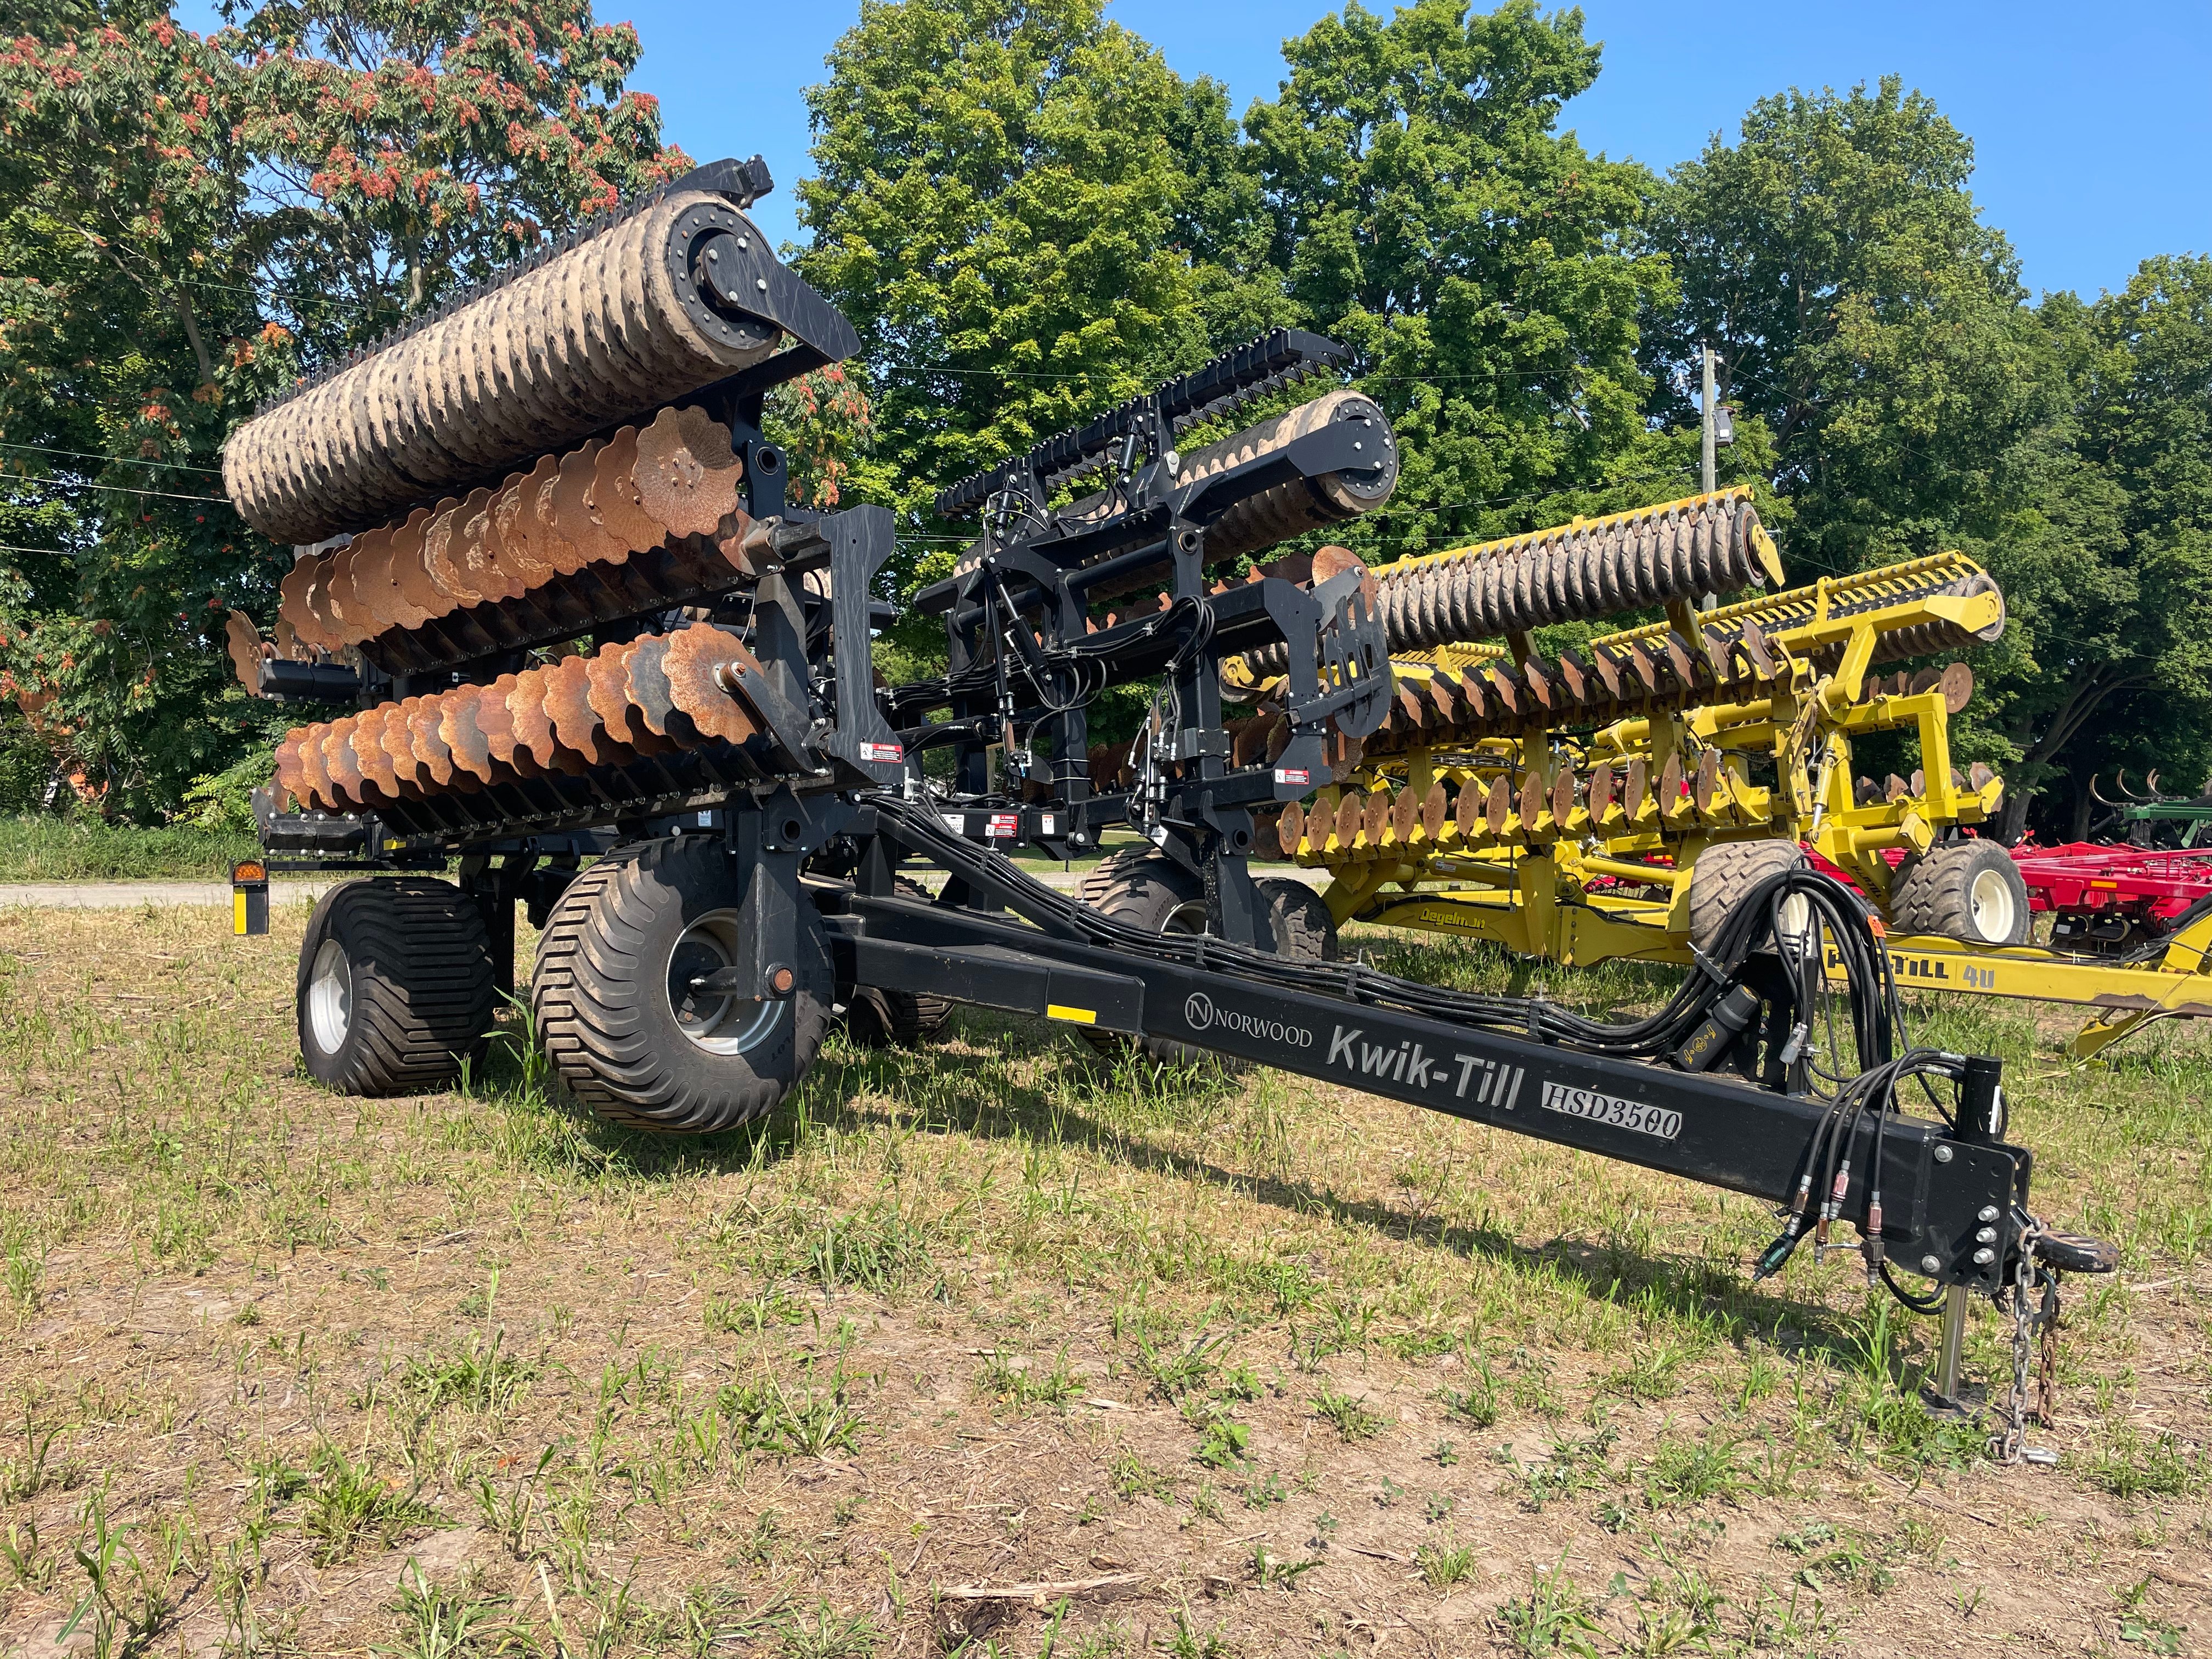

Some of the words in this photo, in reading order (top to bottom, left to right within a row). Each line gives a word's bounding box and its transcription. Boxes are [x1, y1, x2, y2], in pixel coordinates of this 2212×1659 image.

[1962, 964, 1995, 989] 4U
[1215, 1008, 1313, 1047] NORWOOD
[1325, 1024, 1525, 1111] Kwik-Till
[1544, 1084, 1680, 1137] HSD3500
